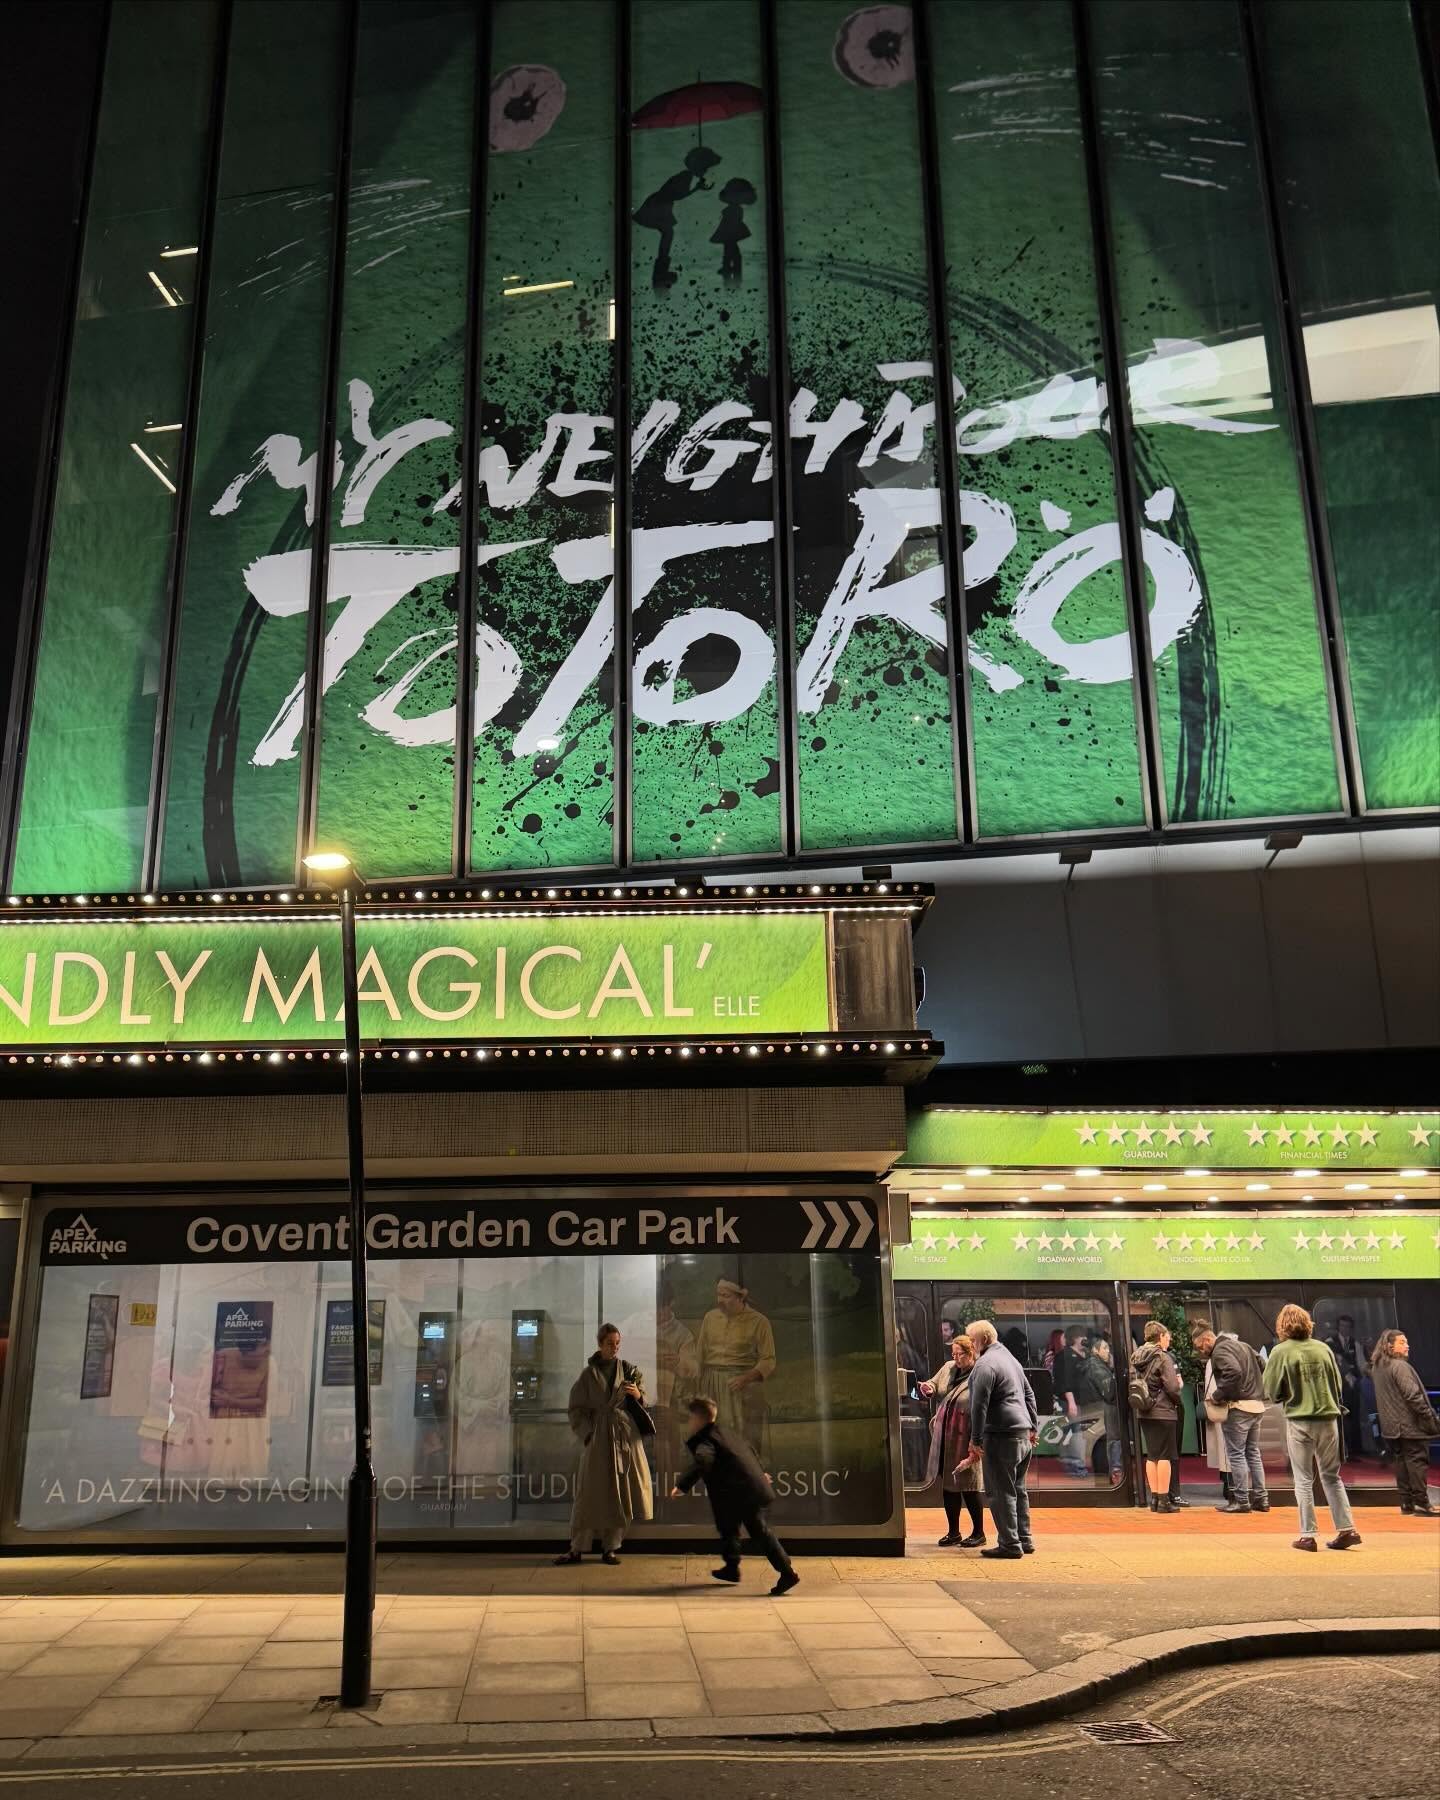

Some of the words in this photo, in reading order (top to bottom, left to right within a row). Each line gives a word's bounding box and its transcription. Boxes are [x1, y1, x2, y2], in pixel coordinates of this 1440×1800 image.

[210, 378, 456, 527] MY
[242, 486, 1203, 768] TOTORO
[241, 941, 713, 1025] MAGICAL'
[713, 995, 761, 1017] ELLE
[1123, 1150, 1168, 1160] GUARDIAN
[1280, 1151, 1323, 1160] FINANCIAL
[1325, 1151, 1348, 1160] TIMES
[50, 1222, 99, 1241] APEX
[186, 1215, 350, 1253] Covent
[365, 1210, 531, 1249] Garden
[547, 1210, 627, 1247] Car
[638, 1207, 741, 1245] Park
[48, 1240, 128, 1254] PARKING
[224, 1320, 264, 1329] PARKING
[226, 1312, 250, 1321] APEX
[40, 1479, 66, 1504] 'A
[77, 1478, 226, 1503] DAZZLING
[238, 1476, 348, 1502] STAGIN
[383, 1475, 423, 1501] OF
[431, 1474, 484, 1500] THE
[496, 1473, 577, 1500] STUDI
[420, 1503, 472, 1513] GUARDIAN
